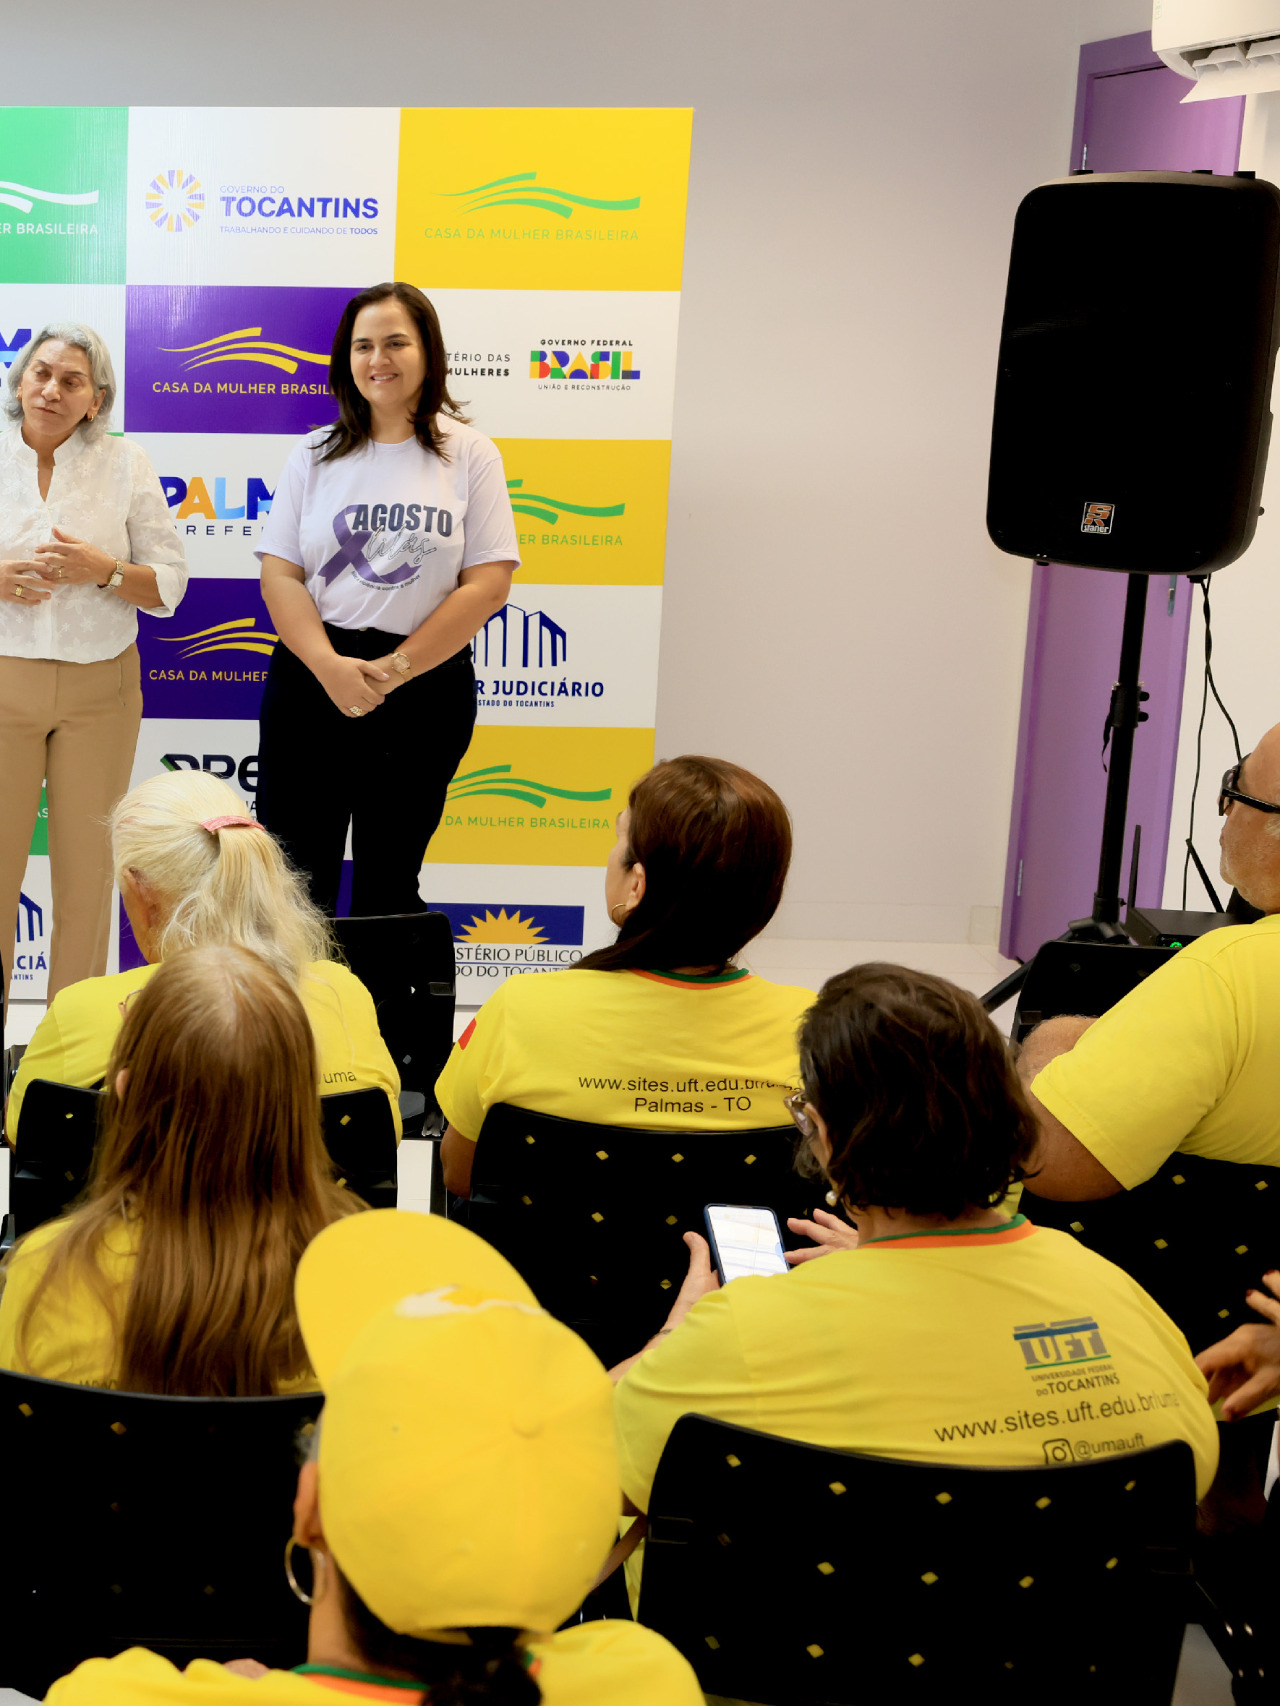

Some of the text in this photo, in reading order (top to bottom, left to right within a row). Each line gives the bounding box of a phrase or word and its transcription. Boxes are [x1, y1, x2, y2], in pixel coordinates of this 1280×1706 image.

[220, 185, 285, 194] GOVERNO DO
[220, 196, 379, 219] TOCANTINS
[16, 223, 99, 235] BRASILEIRA
[220, 226, 281, 234] TRABALHANDO
[290, 226, 335, 235] CUIDANDO
[336, 227, 348, 235] DE
[350, 227, 378, 235] TODOS
[424, 227, 639, 241] CASA DA MULHER BRASILEIRA
[540, 338, 587, 346] GOVERNO
[446, 351, 511, 362] TÉRIO DAS
[529, 350, 641, 379] BRASIL
[152, 381, 334, 395] CASA DA MULHER BRASIL
[571, 384, 631, 392] RECONSTRUÇÃO
[351, 503, 453, 538] AGOSTO
[541, 534, 624, 546] BRASILEIRA
[148, 669, 185, 681] CASA
[189, 670, 208, 681] DA
[492, 676, 604, 698] JUDICIÁRIO
[516, 700, 555, 708] TOCANTINS
[445, 815, 610, 829] DA MULHER BRASILEIRA
[455, 944, 583, 962] STÉRIO PÚBLICO
[477, 965, 499, 977] DO
[634, 1097, 704, 1113] Palmas
[723, 1096, 752, 1111] TO
[1031, 1363, 1114, 1382] UNIVERSIDADE FEDERAL
[1048, 1373, 1120, 1395] TOCANTINS
[1075, 1433, 1146, 1459] @umauft
